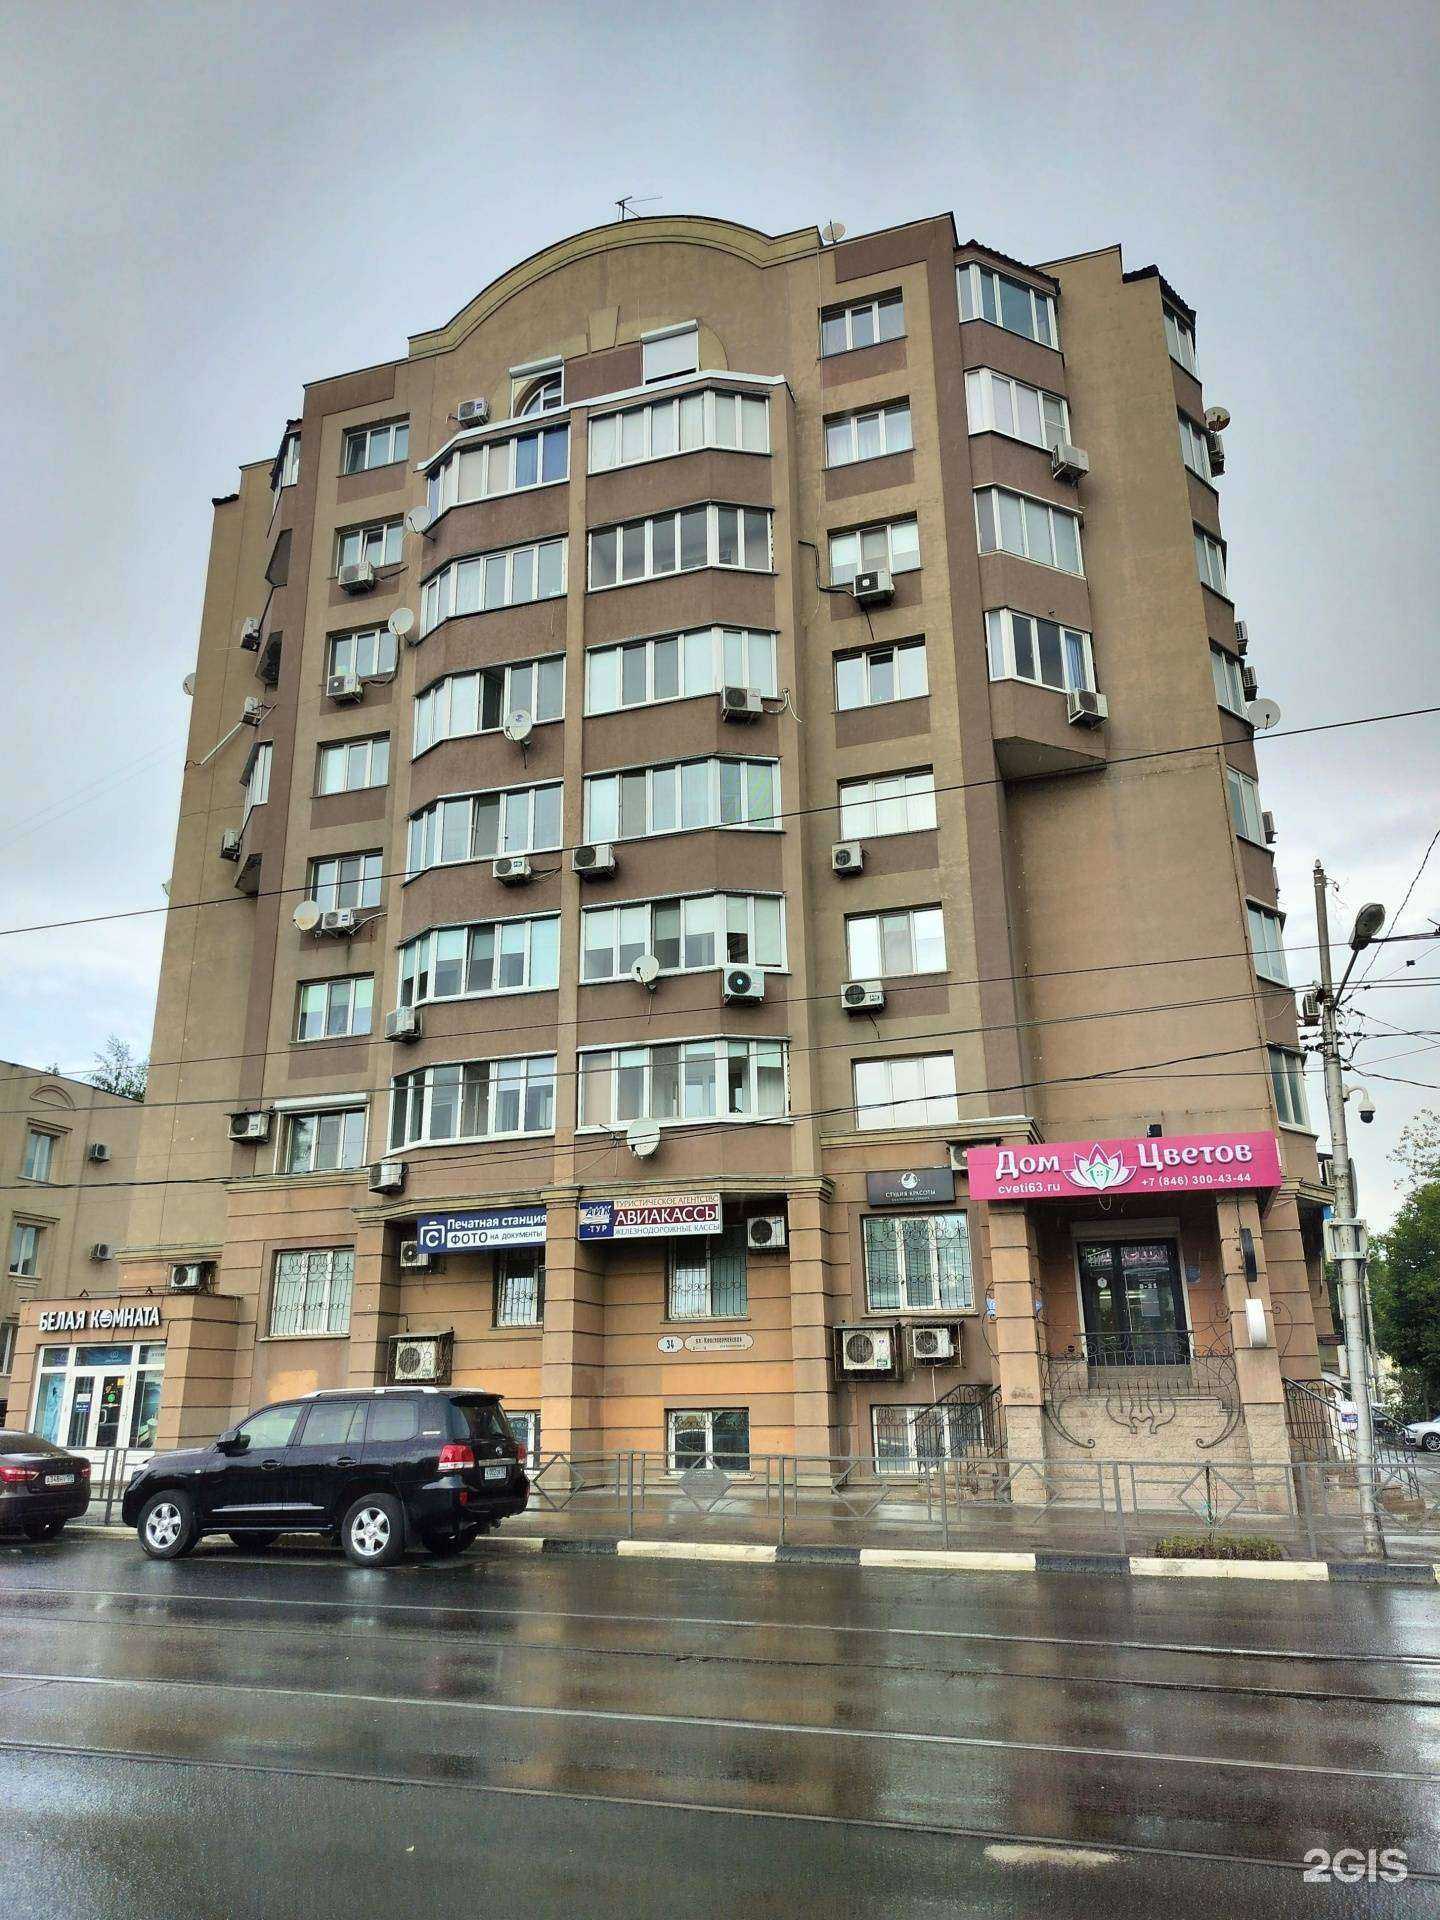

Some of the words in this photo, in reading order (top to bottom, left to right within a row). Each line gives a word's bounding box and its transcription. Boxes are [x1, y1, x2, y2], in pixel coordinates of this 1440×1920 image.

[995, 1150, 1060, 1179] Дом
[1136, 1143, 1252, 1172] Цветов
[1141, 1177, 1154, 1187] +7
[1158, 1174, 1189, 1187] (846)
[1192, 1172, 1251, 1185] 300-43-44
[997, 1181, 1060, 1194] cveti63.ru
[447, 1218, 499, 1230] Печатная
[501, 1214, 547, 1226] станция
[615, 1205, 719, 1226] АВИАКАССЫ
[694, 1223, 720, 1232] КАССЫ
[450, 1231, 488, 1245] ФОТО
[502, 1230, 543, 1241] ДОКУМЕНТЫ
[39, 1310, 85, 1332] БЕЛАЯ
